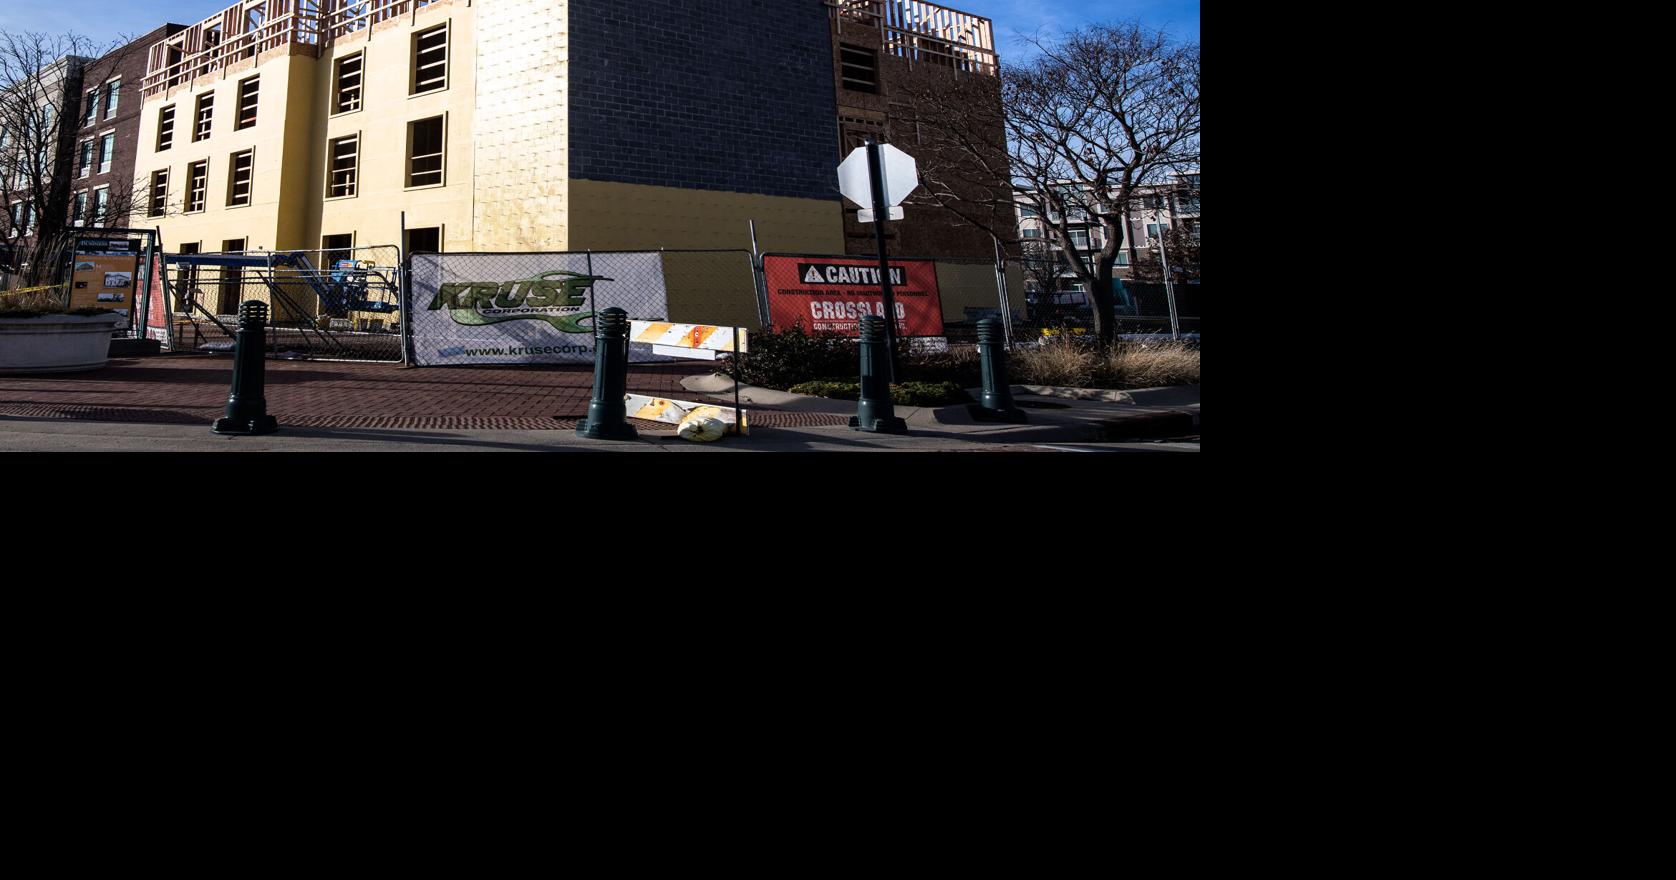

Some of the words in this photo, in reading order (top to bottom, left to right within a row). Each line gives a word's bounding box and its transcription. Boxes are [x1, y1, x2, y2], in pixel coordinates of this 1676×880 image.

[427, 279, 594, 311] KRUSE
[482, 306, 580, 314] CORPORATION
[810, 301, 906, 319] CROSSLAD
[465, 344, 598, 357] www.krusecorp.
